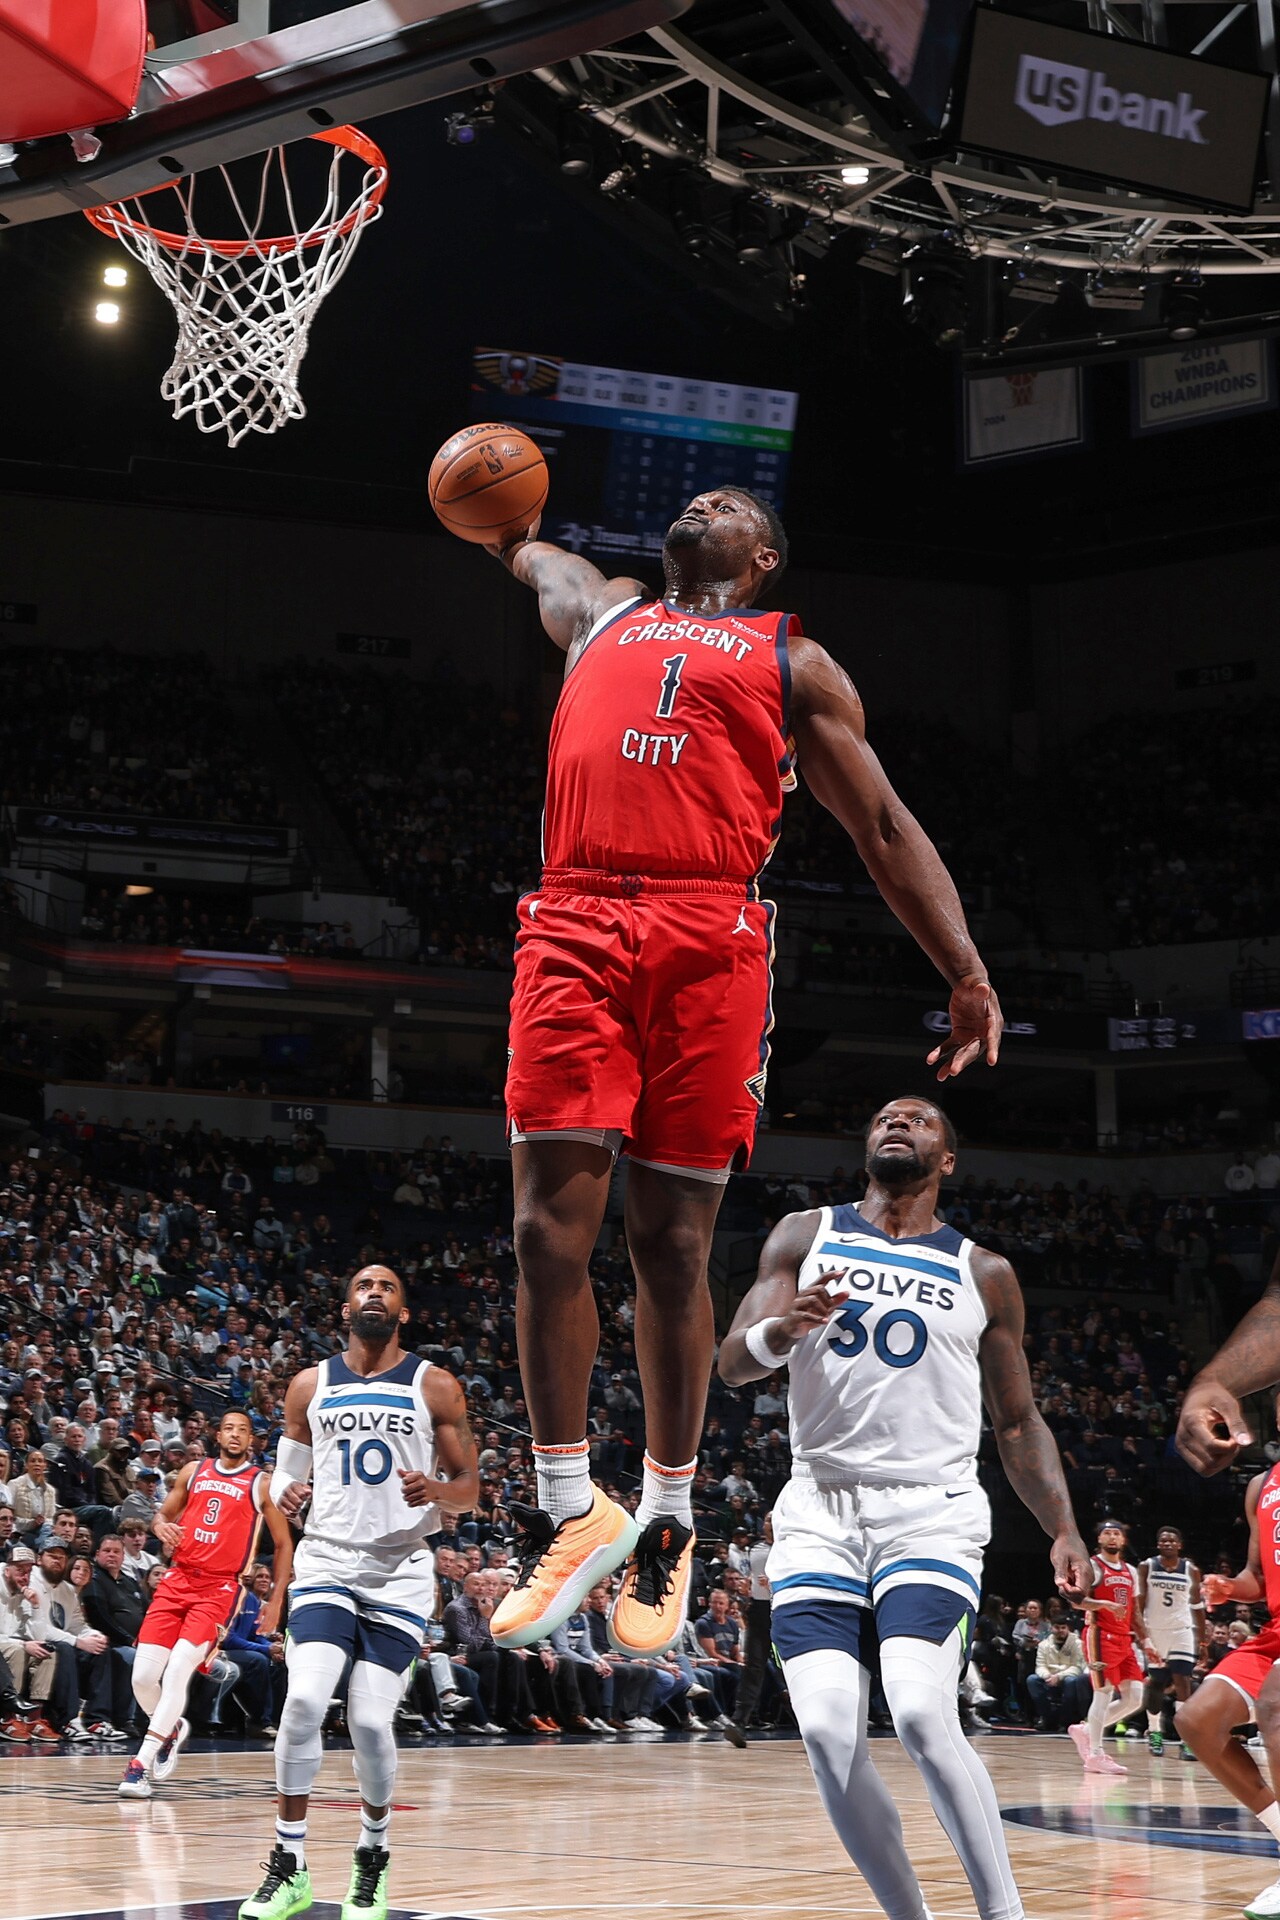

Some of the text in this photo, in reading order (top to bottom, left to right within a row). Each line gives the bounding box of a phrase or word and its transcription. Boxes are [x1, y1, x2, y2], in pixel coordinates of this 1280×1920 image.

[1091, 72, 1209, 145] bank
[1175, 358, 1229, 382] WNBA
[1150, 373, 1257, 409] CHAMPIONS
[0, 605, 15, 620] 6
[357, 637, 389, 654] 217
[618, 620, 752, 662] CRESCENT
[655, 653, 688, 718] 1
[1198, 666, 1233, 685] 219
[621, 728, 689, 766] CITY
[285, 1106, 314, 1121] 116
[818, 1263, 955, 1311] WOLVES
[827, 1299, 928, 1369] 30
[317, 1412, 415, 1436] WOLVES
[337, 1438, 393, 1486] 10
[194, 1480, 244, 1501] CRESCENT
[203, 1498, 222, 1525] 3
[194, 1528, 219, 1544] CITY
[1113, 1587, 1128, 1607] 15
[1151, 1581, 1187, 1592] WOLVES
[1163, 1592, 1174, 1607] 5
